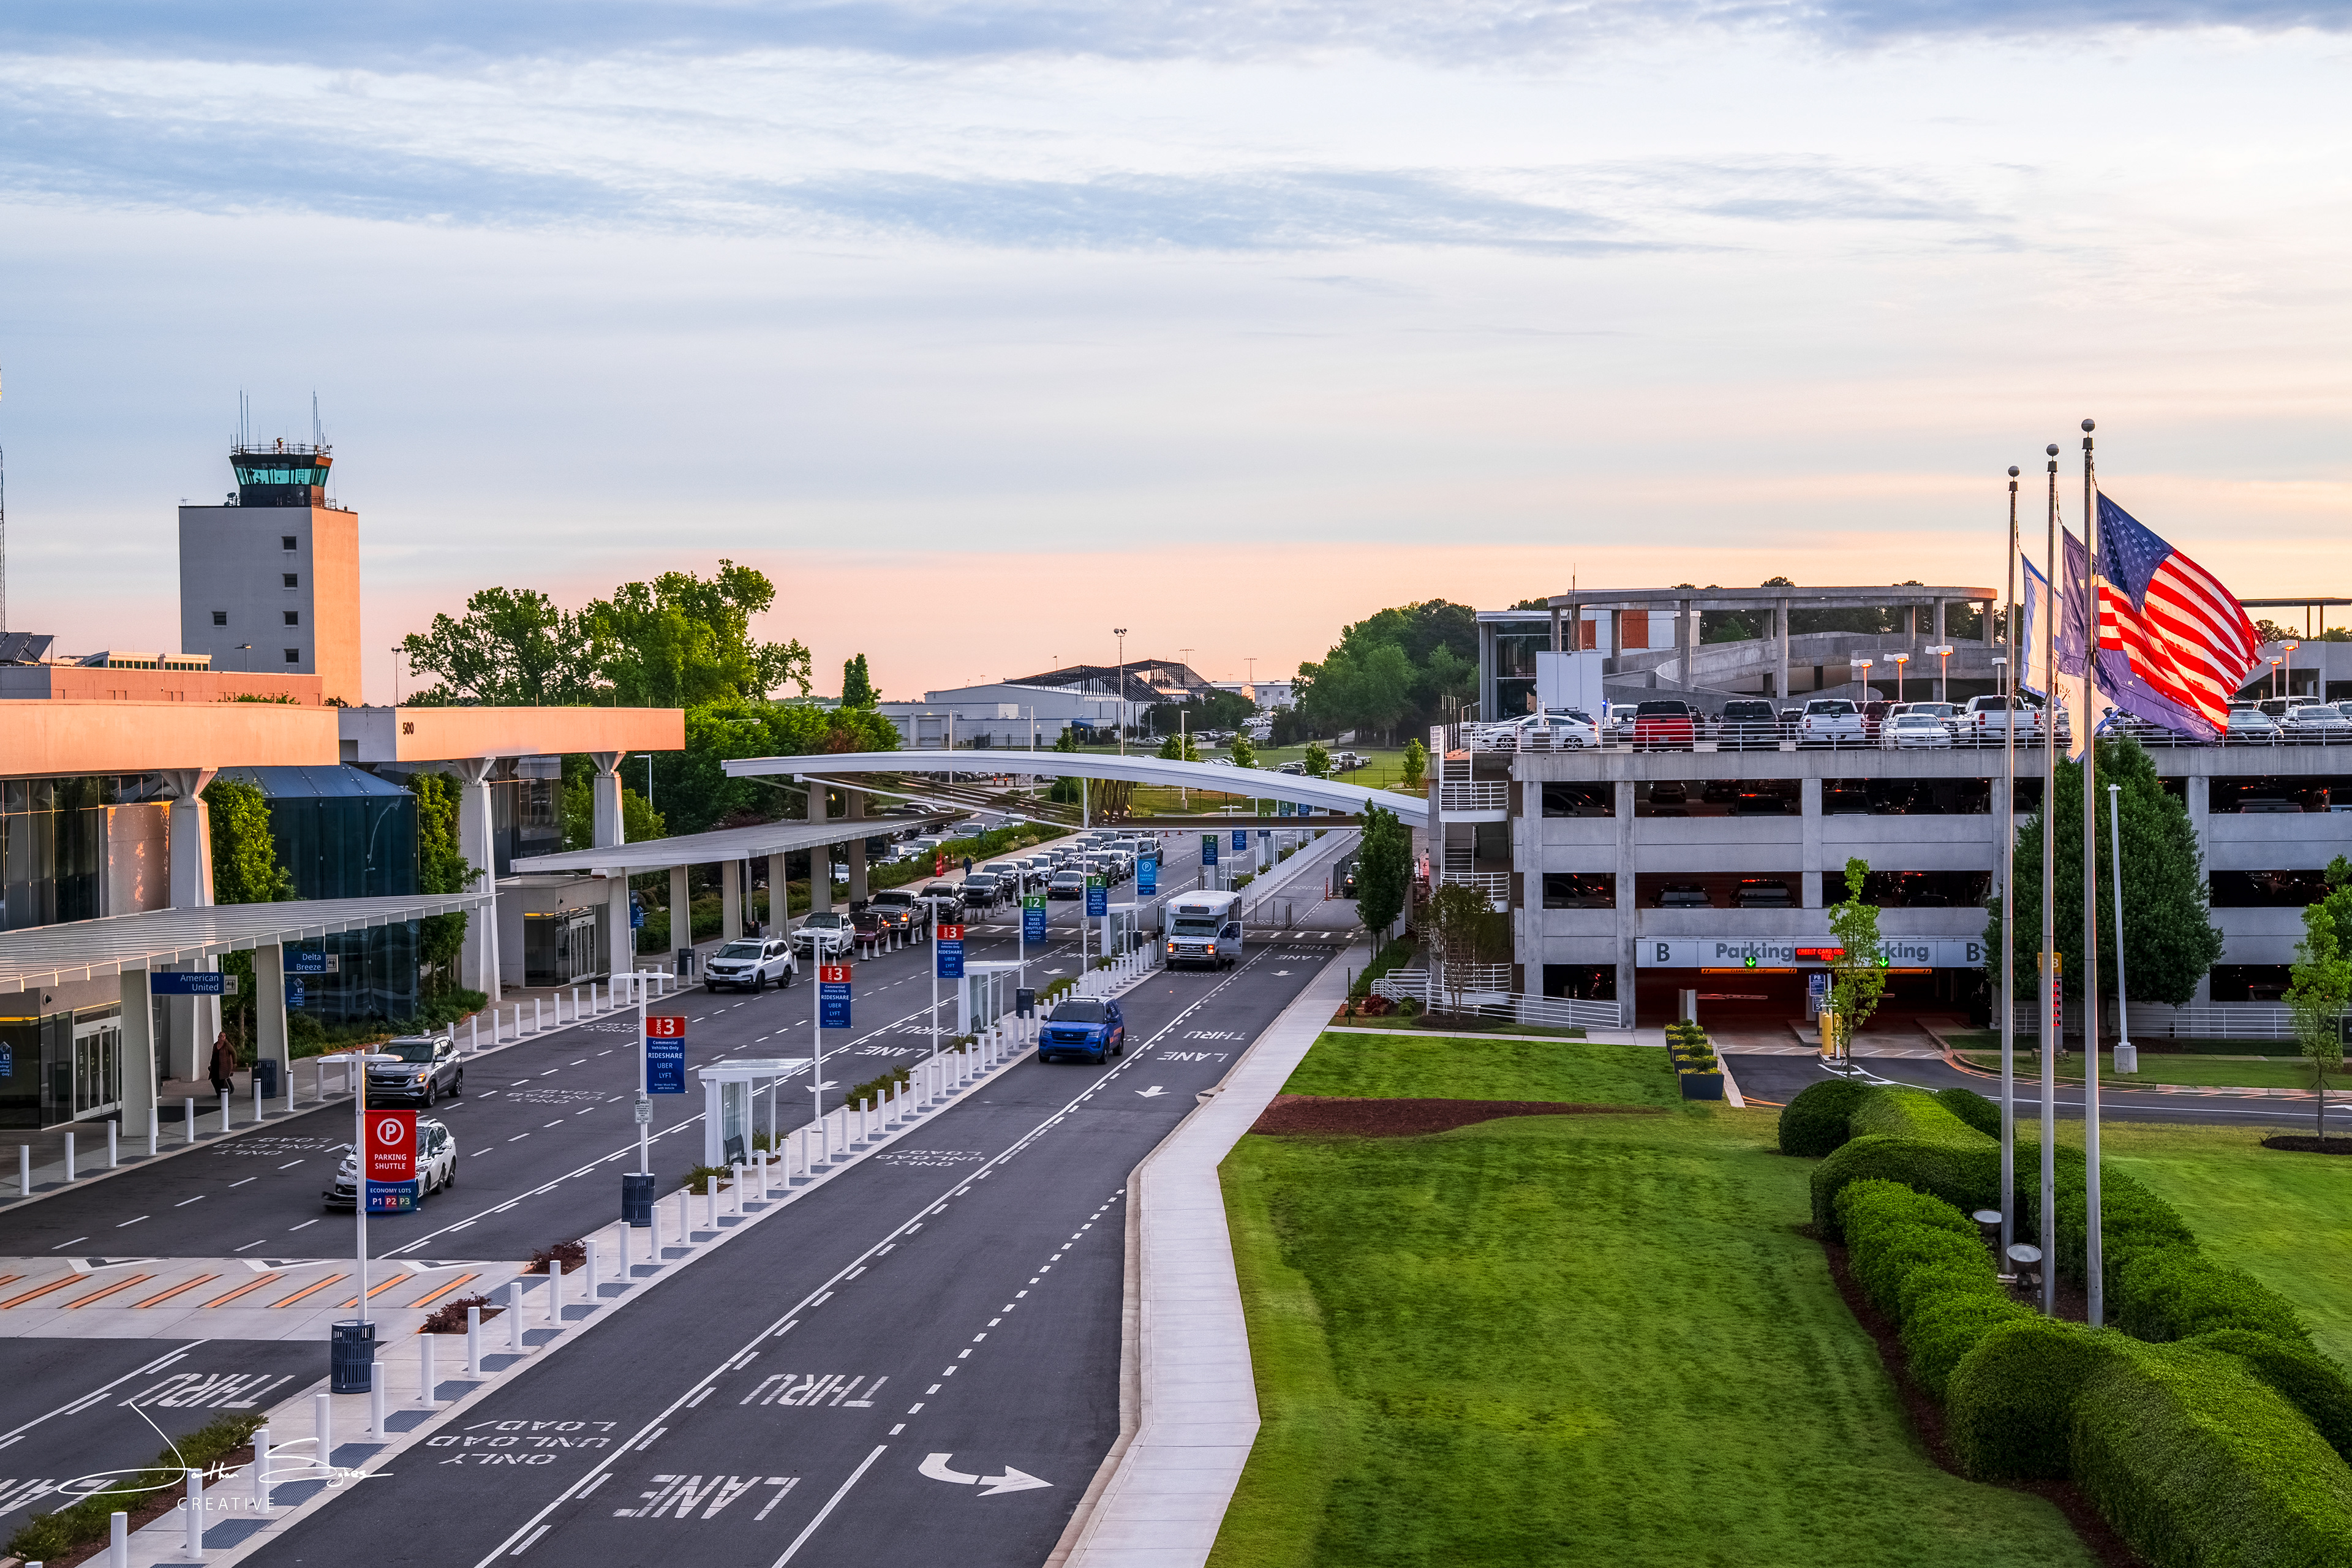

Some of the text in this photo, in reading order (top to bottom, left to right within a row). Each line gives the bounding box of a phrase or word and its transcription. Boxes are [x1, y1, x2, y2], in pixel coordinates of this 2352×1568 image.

[402, 722, 414, 734] 500
[1096, 877, 1102, 886] 2
[1033, 898, 1040, 908] 2
[949, 927, 957, 938] 3
[1657, 943, 1670, 962] B
[1716, 942, 1792, 962] Parking
[1879, 942, 1929, 962] rking
[1966, 943, 1981, 962] B
[834, 968, 843, 981] 3
[664, 1019, 674, 1035] 3
[1183, 1031, 1246, 1040] THRU
[854, 1046, 932, 1058] LANE
[1156, 1052, 1229, 1062] LANE
[117, 1373, 296, 1408] THRU
[739, 1374, 889, 1408] THRU
[464, 1421, 617, 1431] LOAD/
[426, 1436, 611, 1448] UNLOAD
[439, 1453, 557, 1465] ONLY
[612, 1475, 801, 1520] LANE
